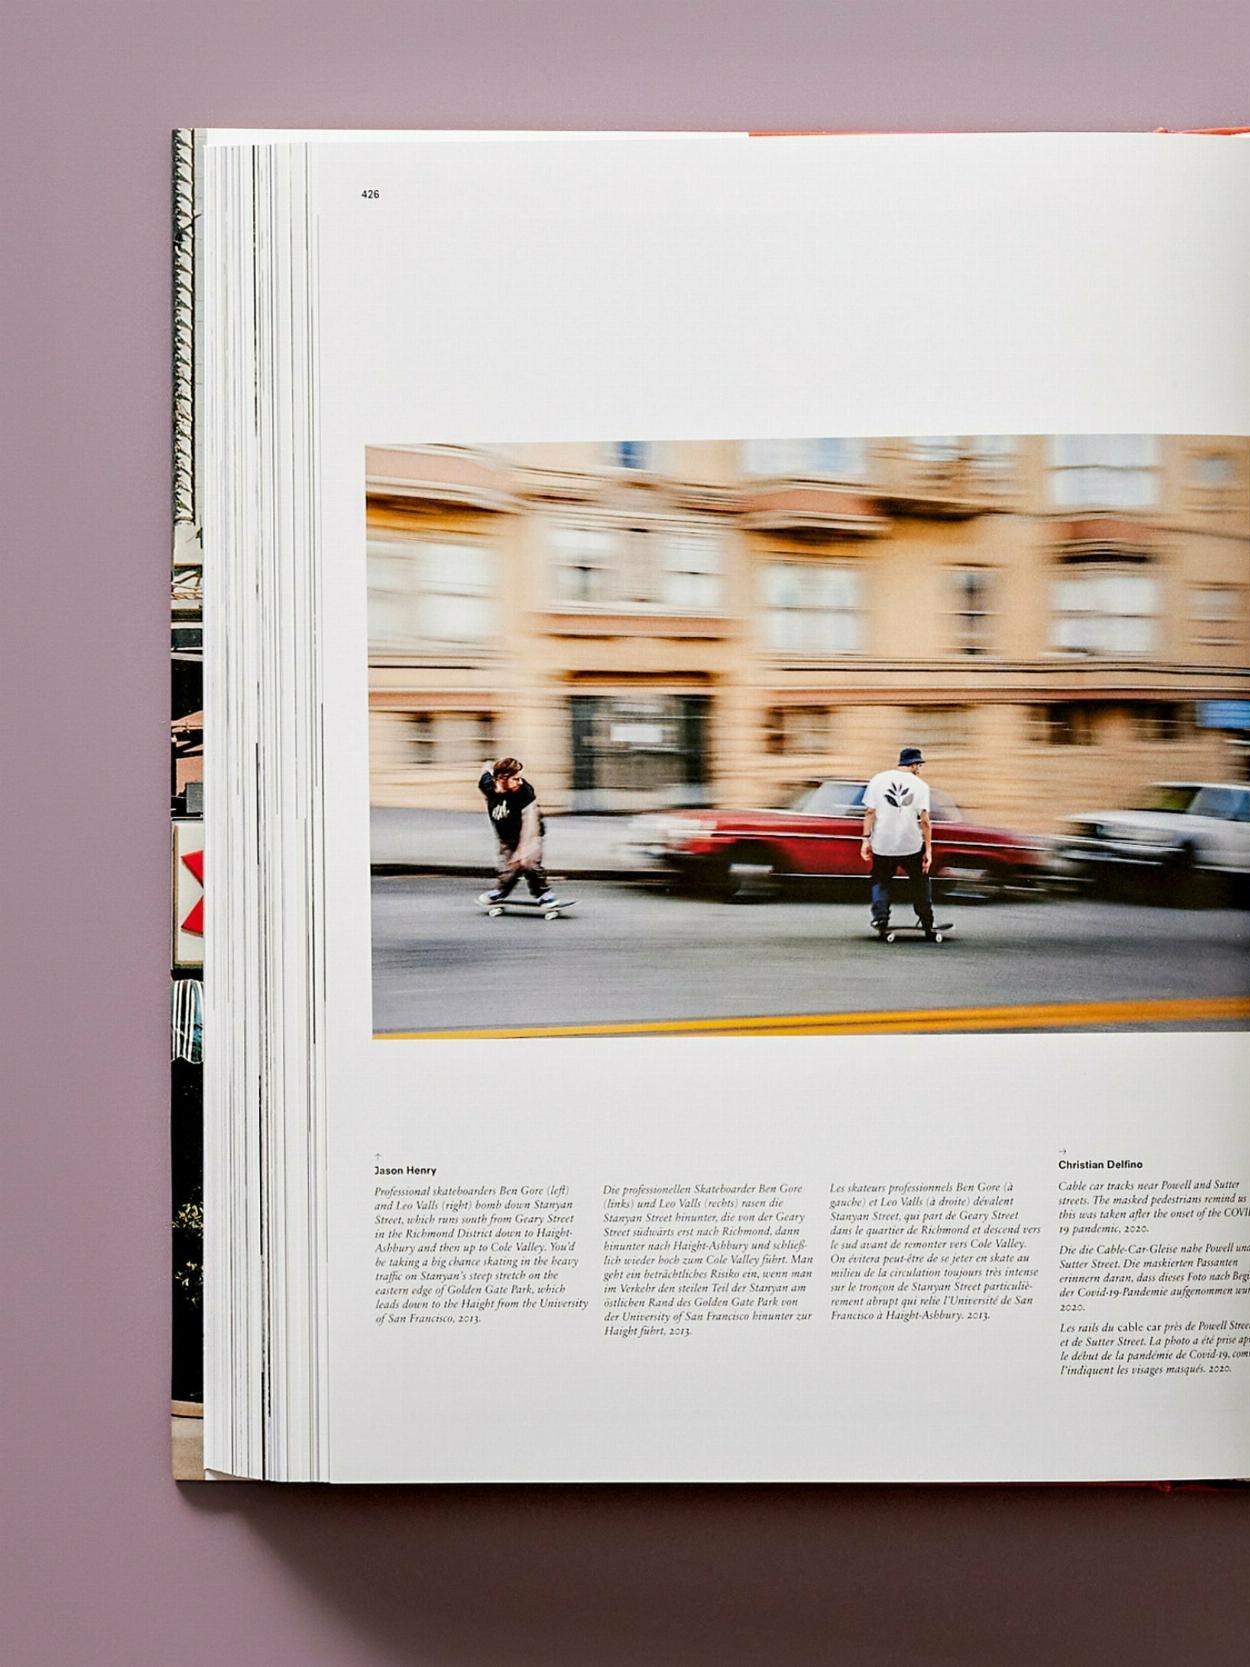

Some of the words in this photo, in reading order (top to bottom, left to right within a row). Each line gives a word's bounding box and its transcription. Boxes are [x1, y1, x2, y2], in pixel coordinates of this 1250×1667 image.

[361, 190, 379, 199] 426
[374, 1165, 404, 1175] Jason
[406, 1165, 437, 1176] Henry
[1058, 1159, 1104, 1169] Christian
[1106, 1159, 1143, 1169] Delfino
[374, 1186, 431, 1198] Professional
[432, 1185, 496, 1195] skateboarders
[499, 1185, 517, 1195] Ben
[520, 1185, 543, 1195] Gore
[602, 1184, 620, 1194] Die
[622, 1183, 691, 1197] professionellen
[694, 1183, 756, 1193] Skateboarder
[758, 1183, 776, 1193] Ben
[779, 1183, 802, 1192] Gore
[829, 1183, 844, 1192] Les
[847, 1182, 885, 1192] skateurs
[887, 1181, 952, 1195] professionnels
[955, 1182, 974, 1192] Ben
[977, 1182, 1000, 1191] Gore
[1058, 1180, 1086, 1191] Cable
[1106, 1180, 1134, 1190] tracks
[1137, 1182, 1158, 1190] near
[1161, 1179, 1192, 1190] Powell
[1193, 1179, 1212, 1189] and
[1213, 1179, 1240, 1189] Sutter
[1093, 1194, 1110, 1204] The
[1112, 1194, 1149, 1204] masked
[1150, 1193, 1201, 1207] pedestrians
[1204, 1192, 1236, 1203] remind
[1237, 1195, 1246, 1203] us
[406, 1214, 435, 1224] which
[461, 1213, 487, 1224] south
[489, 1213, 512, 1224] from
[514, 1214, 544, 1226] Geary
[546, 1213, 574, 1223] Street
[603, 1213, 642, 1225] Stanyan
[645, 1213, 672, 1222] Street
[720, 1211, 735, 1221] die
[757, 1211, 773, 1221] der
[775, 1211, 805, 1224] Geary
[830, 1211, 869, 1224] Stanyan
[903, 1213, 920, 1223] qui
[922, 1212, 942, 1223] part
[945, 1210, 956, 1220] de
[959, 1210, 988, 1223] Geary
[991, 1210, 1018, 1219] Street
[603, 1227, 630, 1237] Street
[632, 1226, 674, 1236] südwärts
[677, 1228, 693, 1236] erst
[696, 1226, 719, 1236] nach
[774, 1225, 800, 1235] dann
[1059, 1226, 1069, 1234] 19
[374, 1242, 415, 1255] Ashbury
[417, 1242, 437, 1252] and
[439, 1242, 460, 1252] then
[463, 1244, 476, 1254] up
[478, 1244, 488, 1252] to
[490, 1241, 512, 1252] Cole
[603, 1240, 645, 1251] hinunter
[647, 1240, 670, 1250] nach
[751, 1239, 771, 1249] und
[773, 1239, 808, 1252] schließ-
[1059, 1245, 1076, 1254] Die
[1078, 1244, 1093, 1254] die
[1180, 1243, 1203, 1253] nahe
[1205, 1242, 1234, 1253] Powell
[1059, 1259, 1088, 1268] Sutter
[1122, 1258, 1140, 1268] Die
[1143, 1257, 1194, 1268] maskierten
[1196, 1257, 1238, 1267] Passanten
[375, 1270, 401, 1283] traffic
[469, 1272, 492, 1283] steep
[495, 1269, 526, 1280] stretch
[543, 1269, 558, 1279] the
[830, 1267, 861, 1277] milieu
[863, 1267, 875, 1277] de
[877, 1267, 887, 1277] la
[889, 1267, 941, 1277] circulation
[943, 1268, 982, 1279] toujours
[985, 1267, 1001, 1276] très
[1004, 1266, 1038, 1276] intense
[1058, 1275, 1100, 1283] erinnern
[1136, 1272, 1155, 1282] dass
[1158, 1271, 1184, 1282] dieses
[1187, 1271, 1207, 1281] Foto
[1209, 1270, 1230, 1280] nach
[375, 1287, 408, 1295] eastern
[411, 1284, 432, 1297] edge
[435, 1284, 445, 1297] of
[447, 1284, 482, 1294] Golden
[484, 1284, 508, 1294] Gate
[537, 1283, 565, 1293] which
[1059, 1287, 1074, 1297] der
[1170, 1285, 1233, 1298] aufgenommen
[831, 1298, 864, 1306] rement
[866, 1295, 898, 1308] abrupt
[900, 1295, 917, 1308] qui
[919, 1295, 940, 1305] relie
[943, 1295, 999, 1305] l'Université
[1000, 1294, 1012, 1304] de
[1014, 1295, 1033, 1304] San
[603, 1311, 619, 1321] der
[622, 1311, 670, 1323] University
[672, 1311, 683, 1324] of
[684, 1311, 703, 1320] San
[706, 1311, 749, 1320] Francisco
[752, 1310, 793, 1320] hinunter
[831, 1310, 874, 1320] Francisco
[876, 1310, 883, 1319] à
[604, 1325, 637, 1338] Haight
[638, 1324, 666, 1338] führt,
[1116, 1364, 1128, 1374] les
[1131, 1367, 1163, 1377] visages
[1165, 1363, 1205, 1376] masqués.
